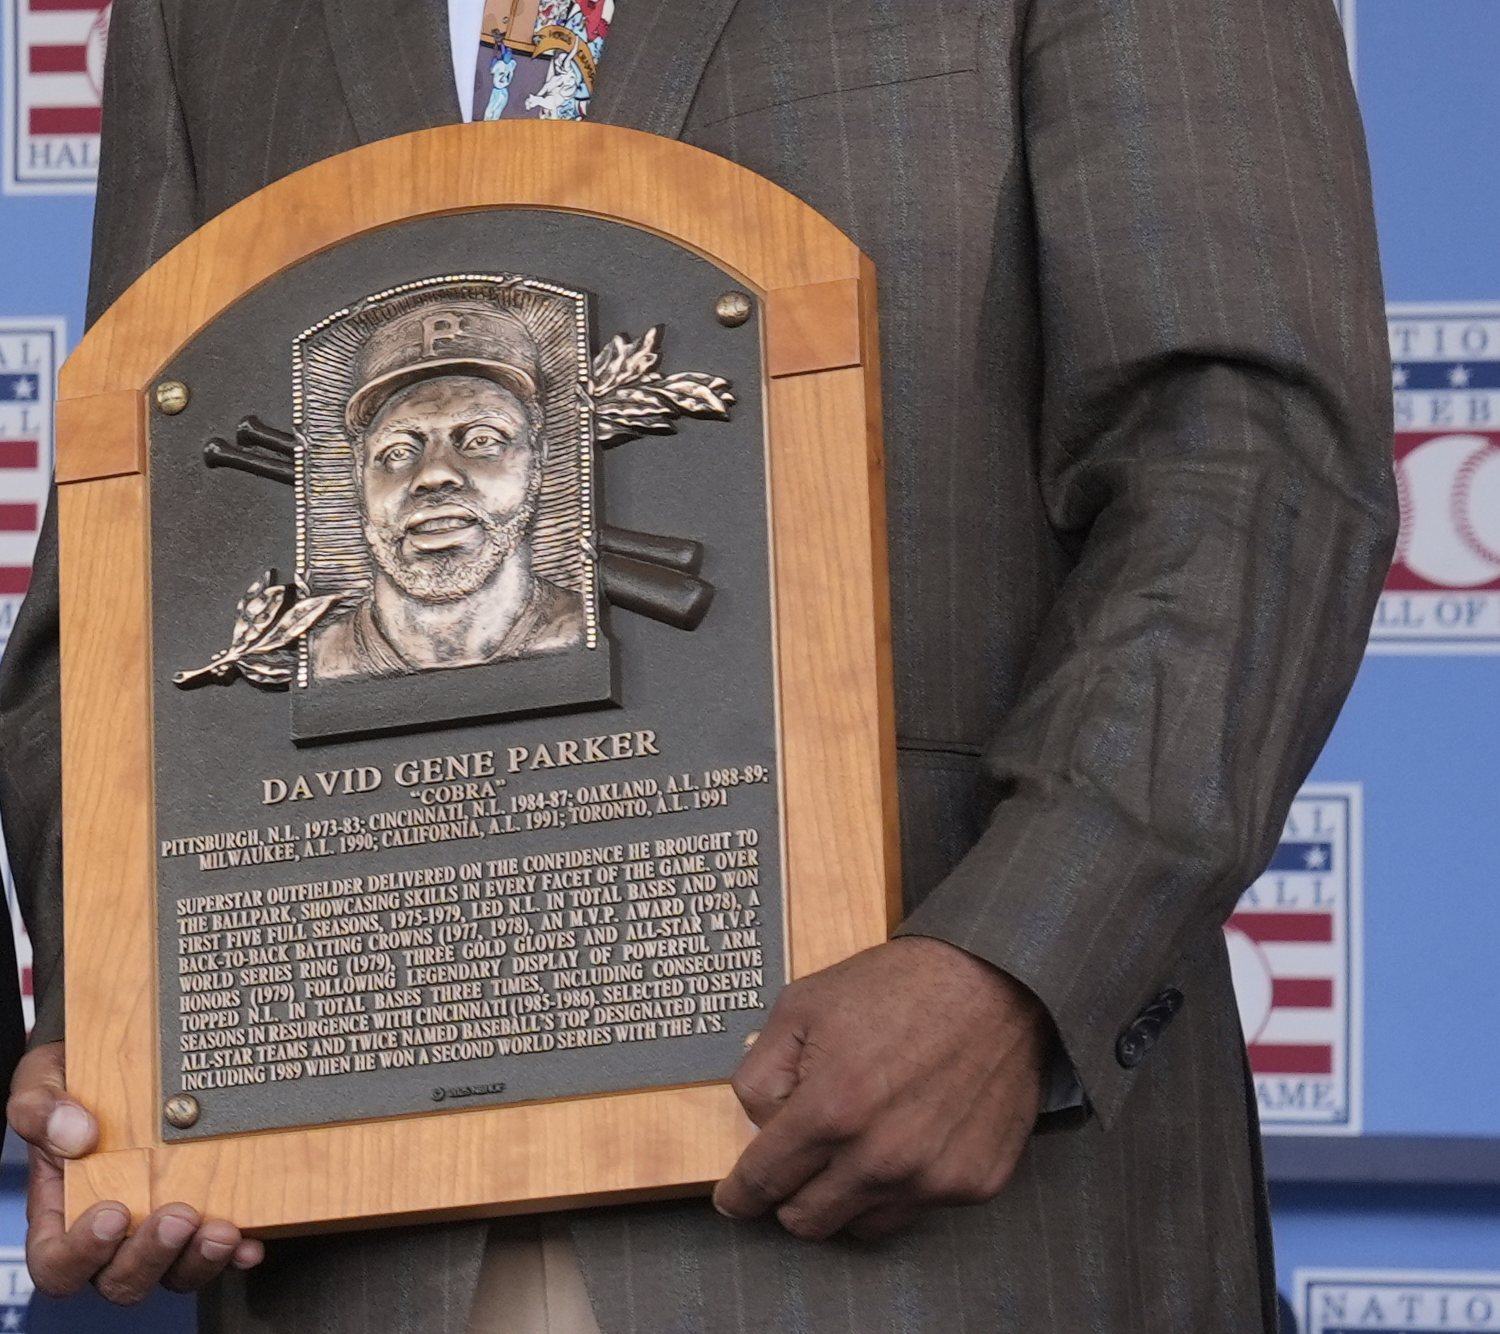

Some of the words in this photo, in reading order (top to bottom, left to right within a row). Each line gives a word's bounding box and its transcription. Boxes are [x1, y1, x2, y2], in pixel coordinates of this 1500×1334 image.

[261, 766, 382, 805] DAVID
[394, 750, 495, 786] GENE
[506, 730, 660, 773] PARKER
[160, 828, 265, 857] PITTSBURGH,
[266, 824, 300, 844] N.L.
[303, 815, 366, 839] 1973-83;
[368, 802, 469, 831] CINCINNATI,
[471, 798, 506, 818] N.L.
[510, 789, 574, 813] 1984-87;
[575, 778, 663, 805] OAKLAND,
[665, 774, 700, 794] A.L.
[197, 842, 300, 871] MILWAUKEE,
[302, 838, 335, 858] A.L.
[339, 832, 379, 853] 1990;
[381, 819, 485, 848] CALIFORNIA,
[487, 815, 521, 835] A.L.
[525, 810, 566, 830] 1991;
[567, 799, 653, 824] TORONTO,
[655, 795, 689, 814] A.L.
[692, 789, 728, 809] 1991
[175, 889, 264, 916] SUPERSTAR
[266, 877, 364, 905] OUTFIELDER
[366, 866, 456, 893] DELIVERED
[458, 863, 483, 881] ON
[485, 858, 519, 878] THE
[522, 846, 624, 873] CONFIDENCE
[627, 842, 651, 861] HE
[654, 833, 732, 857] BROUGHT
[734, 830, 758, 848] TO
[1322, 1292, 1495, 1329] NATIO
